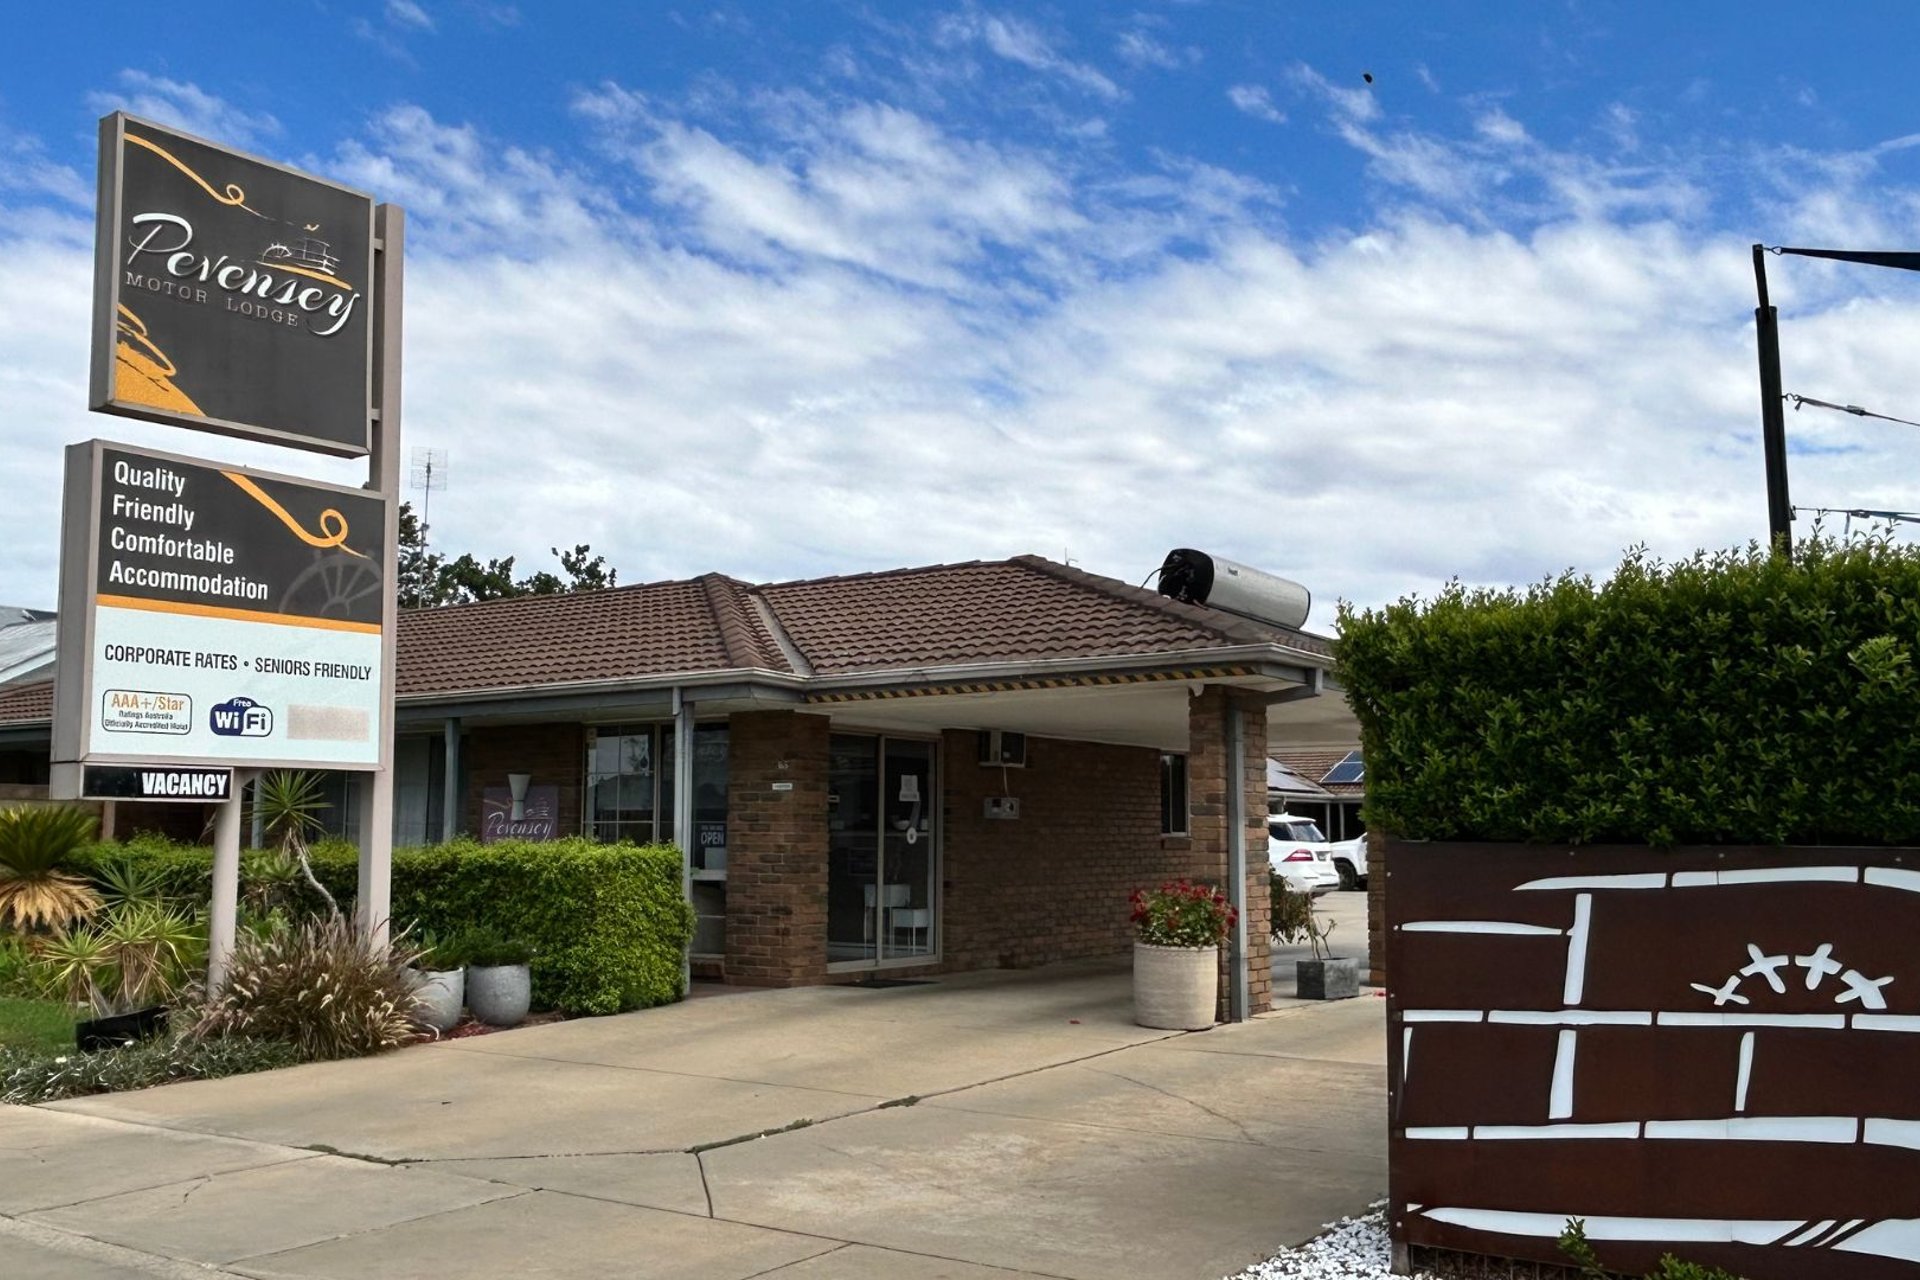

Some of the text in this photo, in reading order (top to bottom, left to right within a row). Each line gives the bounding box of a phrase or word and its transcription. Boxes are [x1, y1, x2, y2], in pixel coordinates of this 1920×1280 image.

[127, 212, 360, 335] Pevensey
[125, 271, 299, 327] MOTOR LODGE
[114, 460, 185, 497] Quality
[113, 494, 195, 531] Friendly
[111, 527, 235, 565] Comfortable
[109, 560, 269, 601] Accommodation
[104, 644, 372, 681] CORPORATE RATES SENIORS FRIENDLY
[142, 772, 227, 796] VACANCY
[700, 831, 725, 845] OPEN
